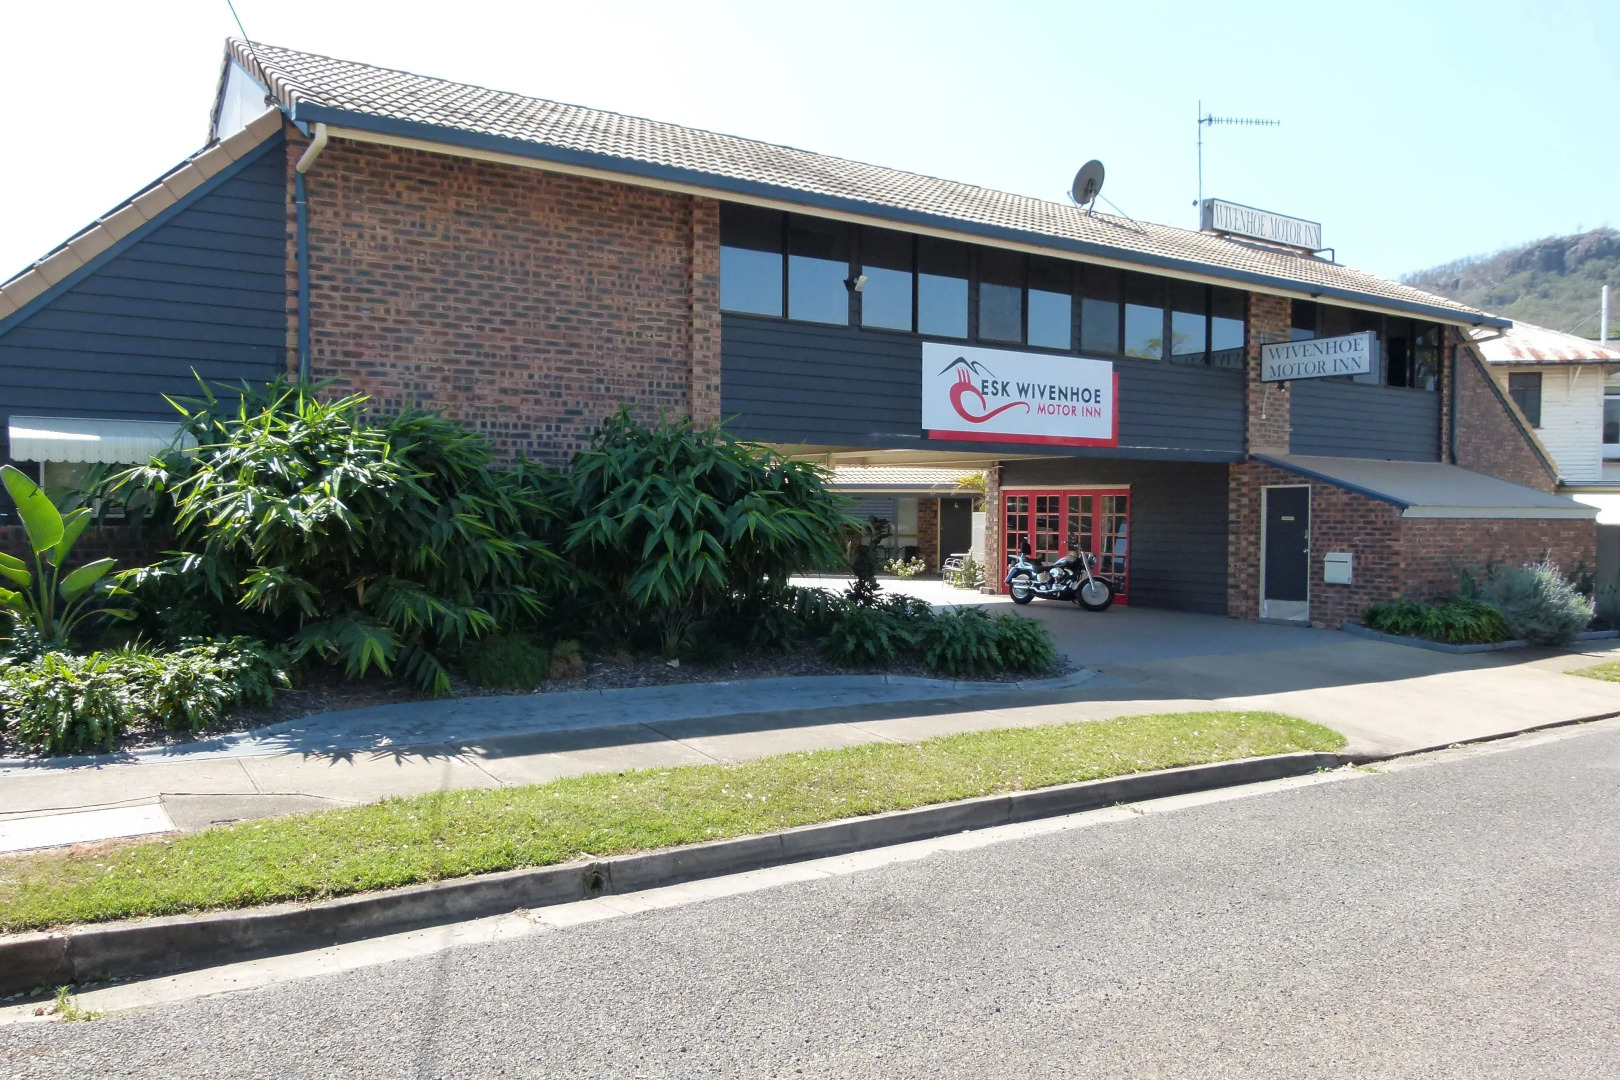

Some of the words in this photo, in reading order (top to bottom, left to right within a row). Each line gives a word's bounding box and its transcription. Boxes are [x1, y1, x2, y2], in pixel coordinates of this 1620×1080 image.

[1215, 203, 1265, 236] WIVENHOE
[1270, 216, 1302, 244] MOTOR
[1304, 224, 1320, 248] INN
[1268, 337, 1364, 360] WIVENHOE
[1269, 360, 1326, 378] MOTOR
[1333, 357, 1362, 372] INN
[1016, 382, 1101, 404] WIVENHOE
[1037, 403, 1077, 417] MOTOR
[1082, 406, 1102, 418] INN
